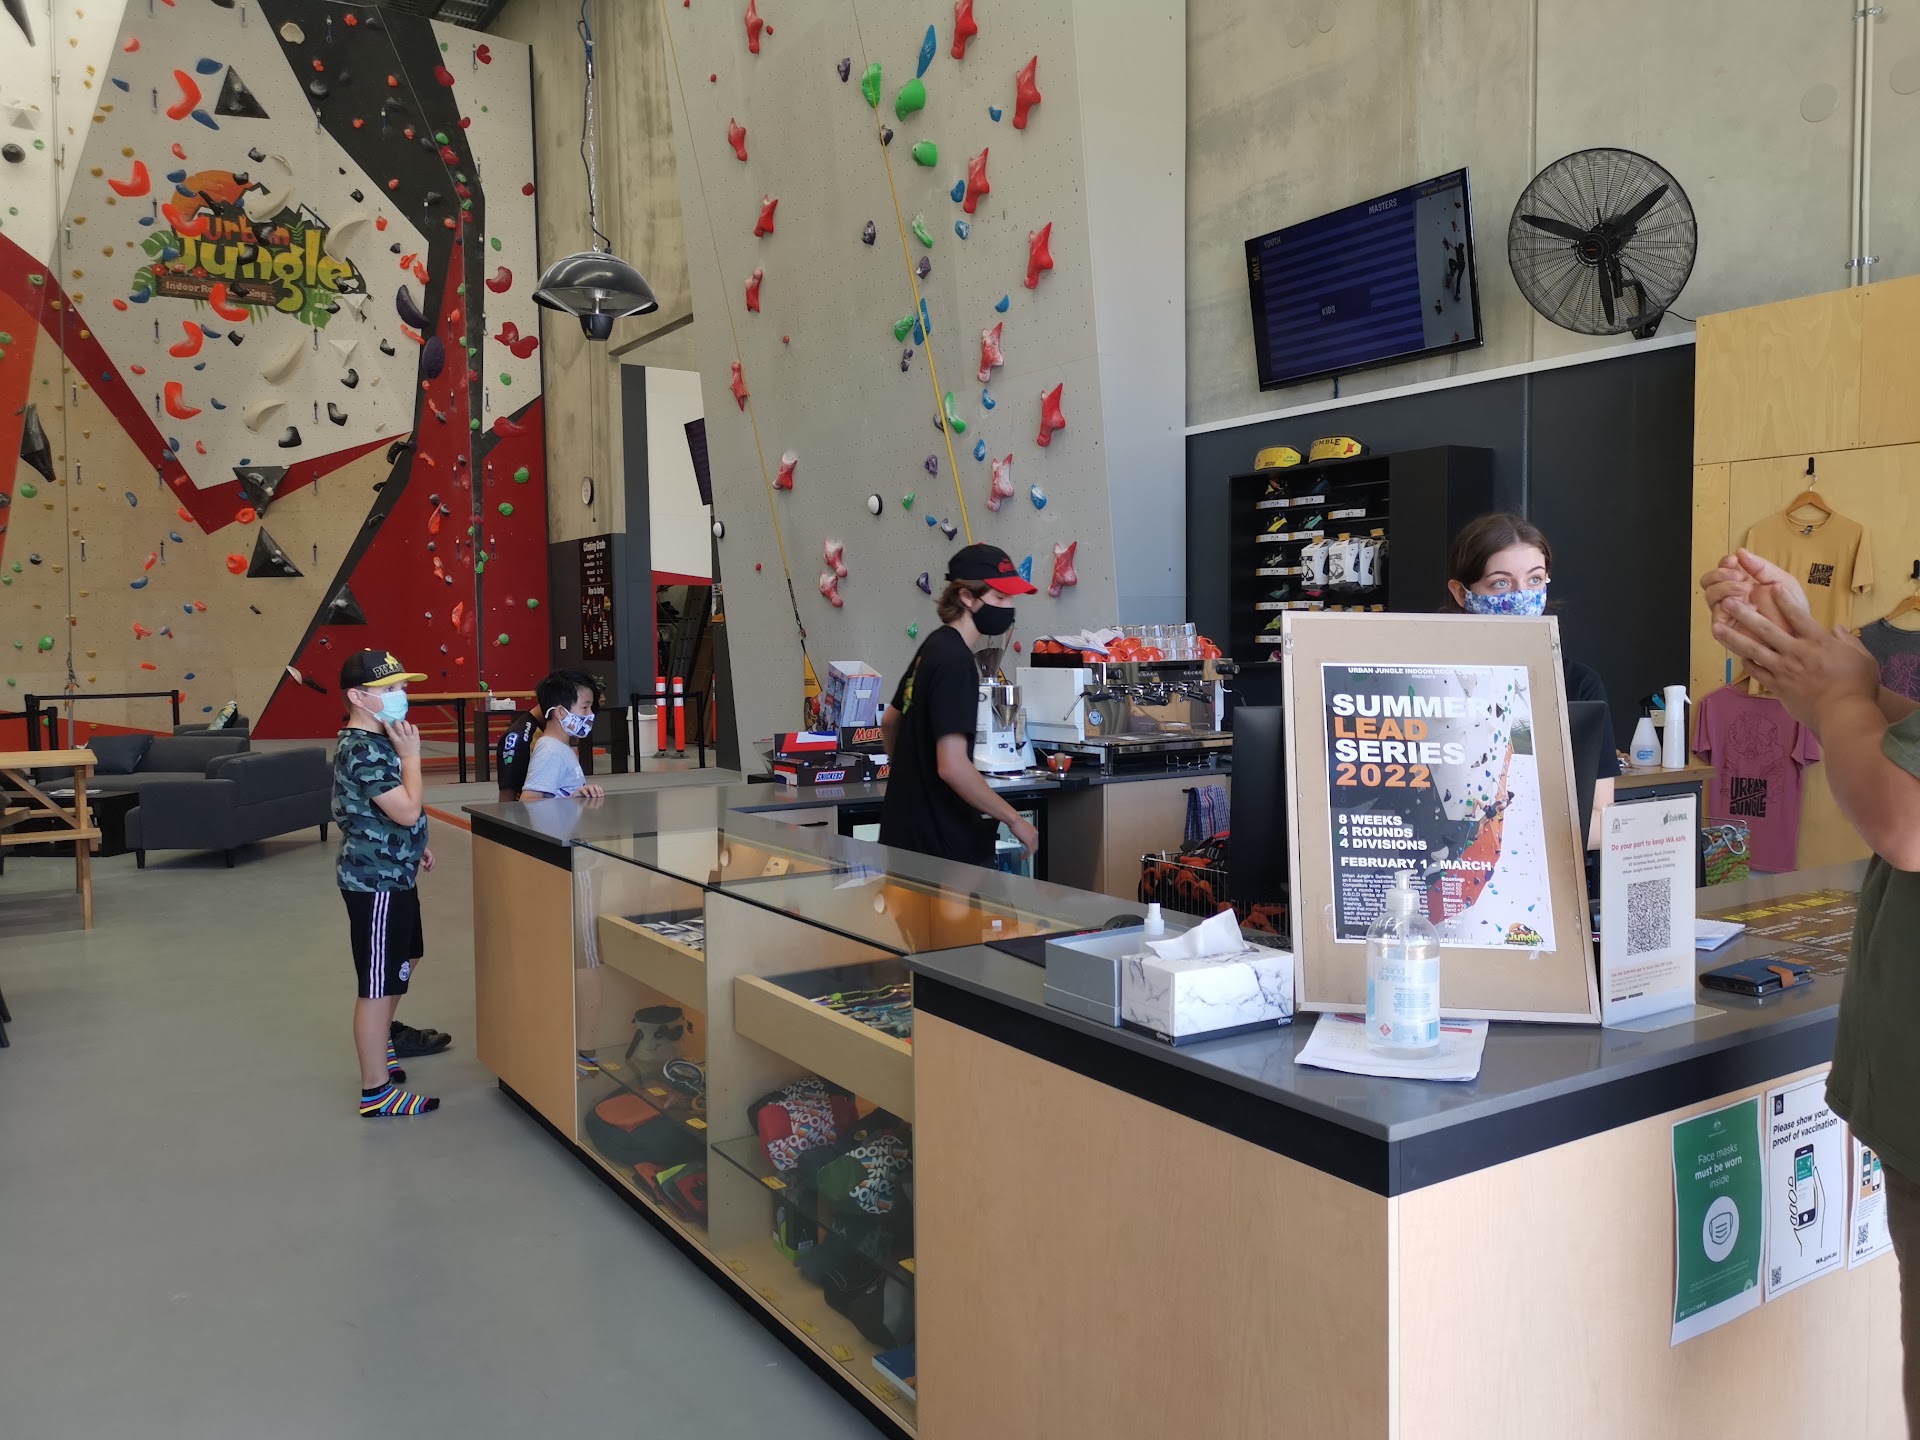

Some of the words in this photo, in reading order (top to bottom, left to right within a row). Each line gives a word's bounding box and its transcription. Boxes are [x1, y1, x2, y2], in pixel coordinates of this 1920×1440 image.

[1368, 198, 1398, 215] MASTERS
[205, 213, 291, 246] Urbn
[1263, 236, 1281, 249] YOUTH
[165, 281, 201, 293] Indoor
[1321, 305, 1336, 317] KIDS
[1810, 562, 1834, 576] URBAN
[1332, 693, 1489, 718] SUMMER
[1334, 717, 1428, 740] LEAD
[1335, 739, 1466, 765] SERIES
[817, 771, 844, 781] SNICKERS
[1336, 763, 1431, 787] 2022
[1730, 776, 1768, 800] URBAN
[1730, 794, 1767, 818] JUNGLE
[1338, 814, 1347, 824] 8
[1351, 815, 1402, 826] WEEKS
[1339, 826, 1348, 836] 4
[1352, 827, 1414, 838] ROUNDS
[1340, 838, 1349, 848] 4
[1353, 839, 1427, 850] DIVISIONS
[1620, 843, 1632, 851] your
[1633, 841, 1644, 850] part
[1652, 838, 1664, 846] keep
[1340, 857, 1416, 868] FEBRUARY
[1420, 859, 1428, 869] 1
[1440, 860, 1492, 871] MARCH
[1773, 1121, 1795, 1135] Please
[1796, 1115, 1813, 1127] show
[1814, 1108, 1829, 1122] your
[1772, 1134, 1791, 1149] proof
[1792, 1130, 1800, 1140] of
[1800, 1117, 1838, 1137] vaccination
[1698, 1152, 1715, 1165] Face
[1716, 1144, 1738, 1159] masks
[1695, 1166, 1713, 1180] must
[1714, 1163, 1723, 1173] be
[1724, 1155, 1742, 1169] worn
[1709, 1174, 1730, 1189] inside
